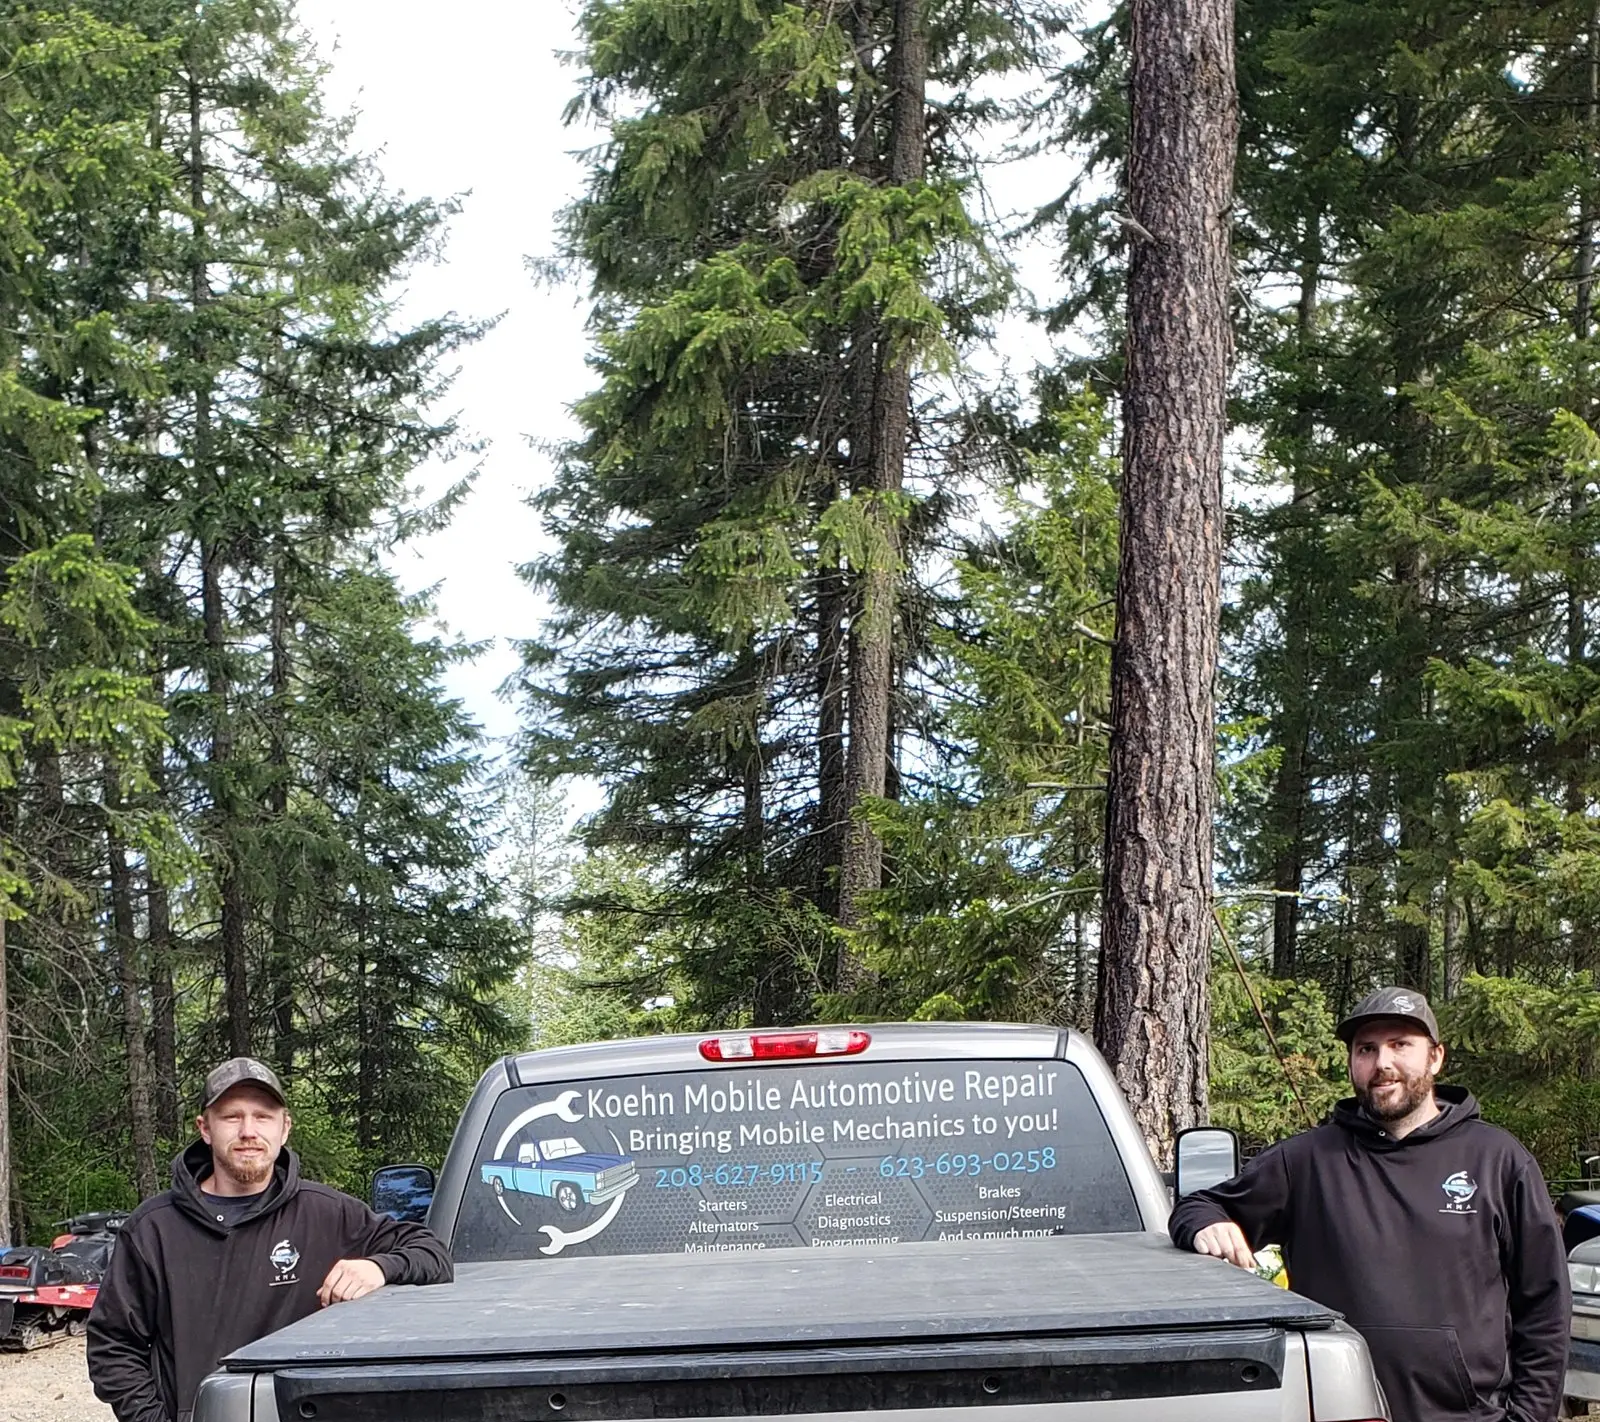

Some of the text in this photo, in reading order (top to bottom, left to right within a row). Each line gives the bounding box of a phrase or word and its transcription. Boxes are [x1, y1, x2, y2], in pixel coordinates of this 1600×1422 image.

[588, 1065, 1057, 1118] Koehn Mobile Automotive Repair
[629, 1109, 1058, 1155] Bringing Mobile Mechanics to you!
[655, 1161, 823, 1188] 208-627-9115
[880, 1147, 1056, 1179] 623-693-0258
[825, 1192, 882, 1207] Electrical
[978, 1186, 1021, 1200] Brakes
[699, 1200, 747, 1212] Starters
[935, 1204, 1066, 1225] Suspension/Steering
[688, 1221, 759, 1234] Alternators
[818, 1215, 891, 1230] Diagnostics
[684, 1242, 766, 1254] Maintenance
